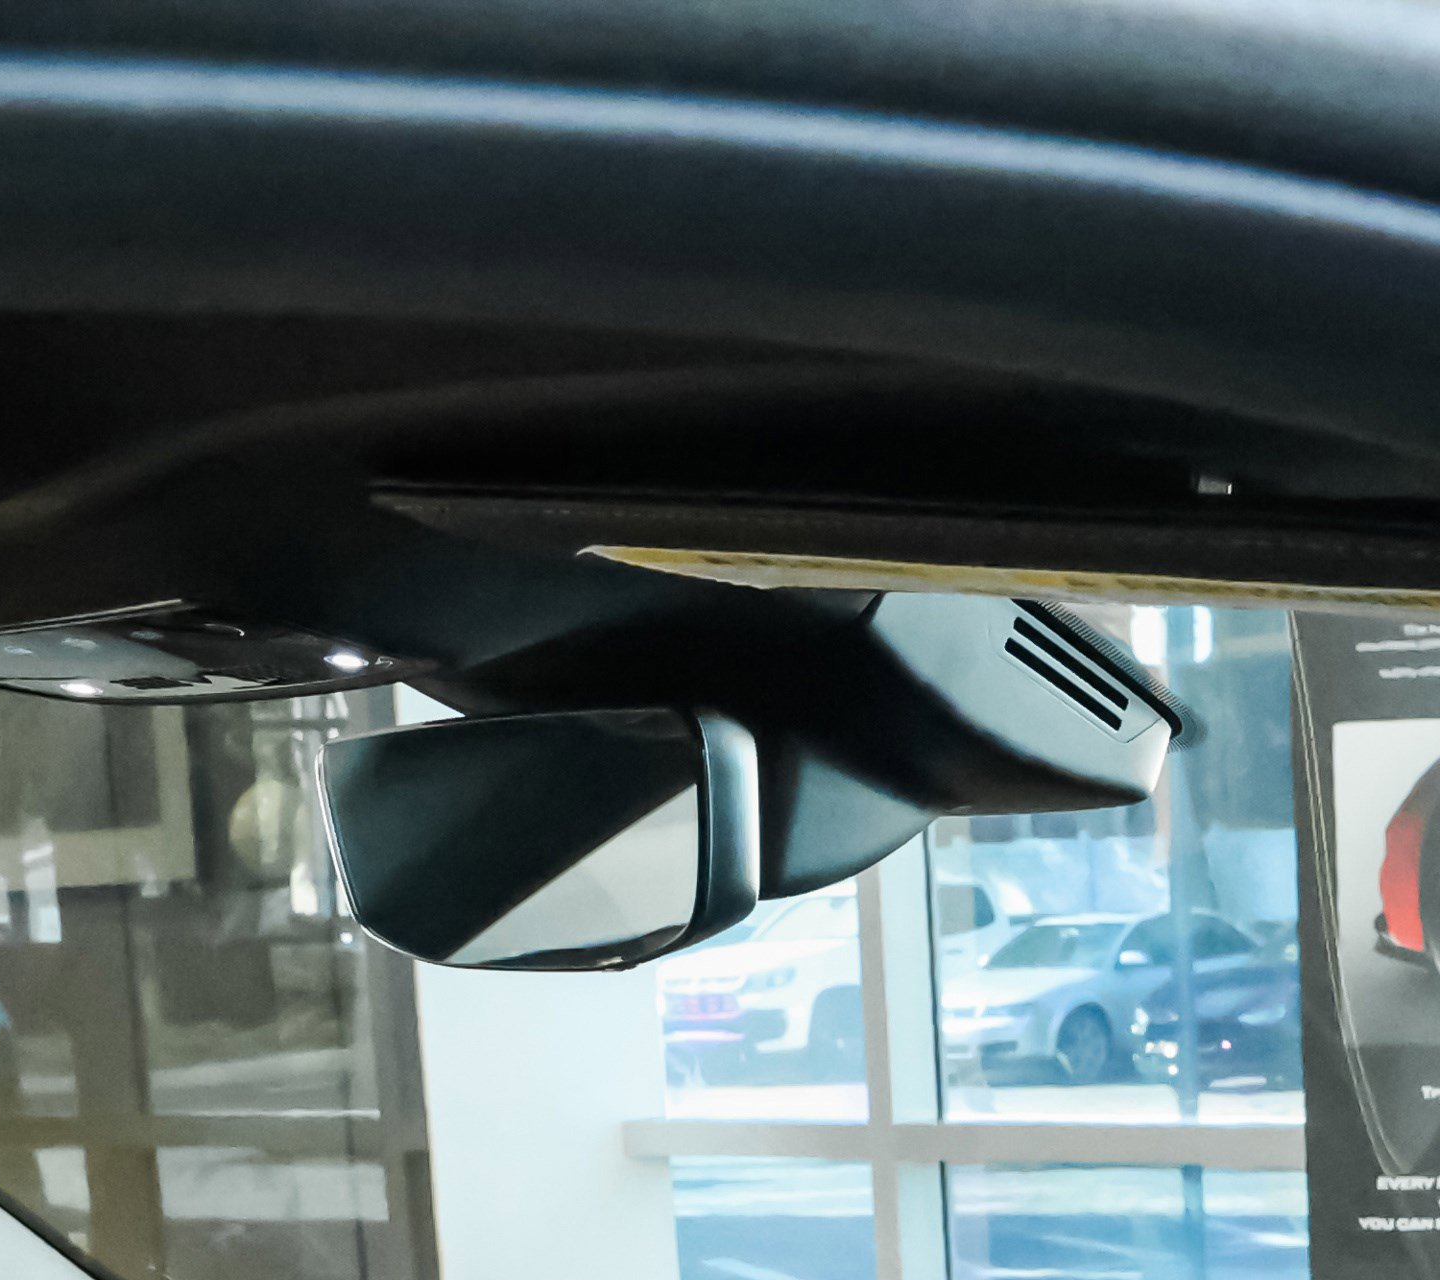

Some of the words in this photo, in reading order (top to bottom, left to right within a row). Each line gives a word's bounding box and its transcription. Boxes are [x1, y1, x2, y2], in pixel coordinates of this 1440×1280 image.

[1376, 1176, 1434, 1190] EVERY
[1358, 1217, 1394, 1231] YOU
[1395, 1217, 1434, 1231] CAN
